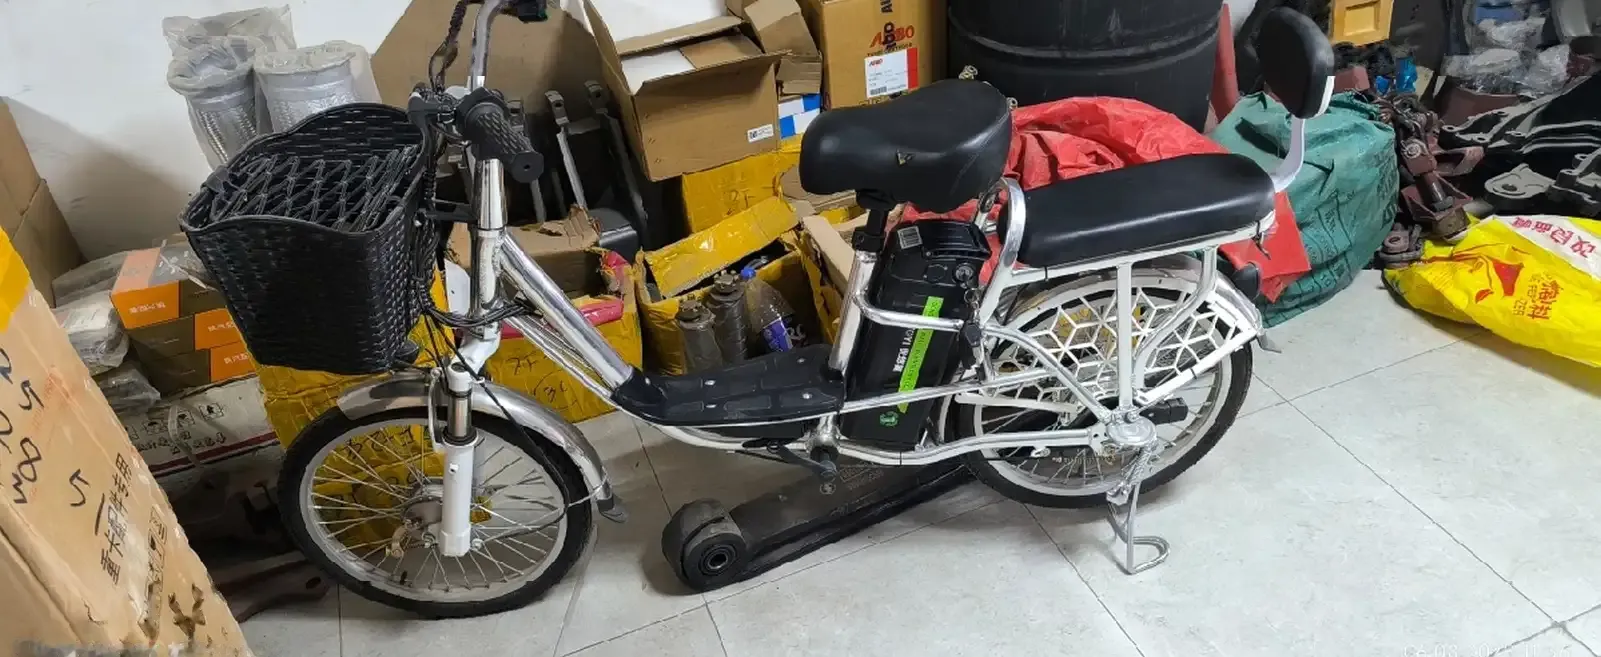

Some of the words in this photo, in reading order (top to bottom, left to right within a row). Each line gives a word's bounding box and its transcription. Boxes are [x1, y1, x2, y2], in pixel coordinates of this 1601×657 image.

[100, 452, 132, 585] 重卡配件专用
